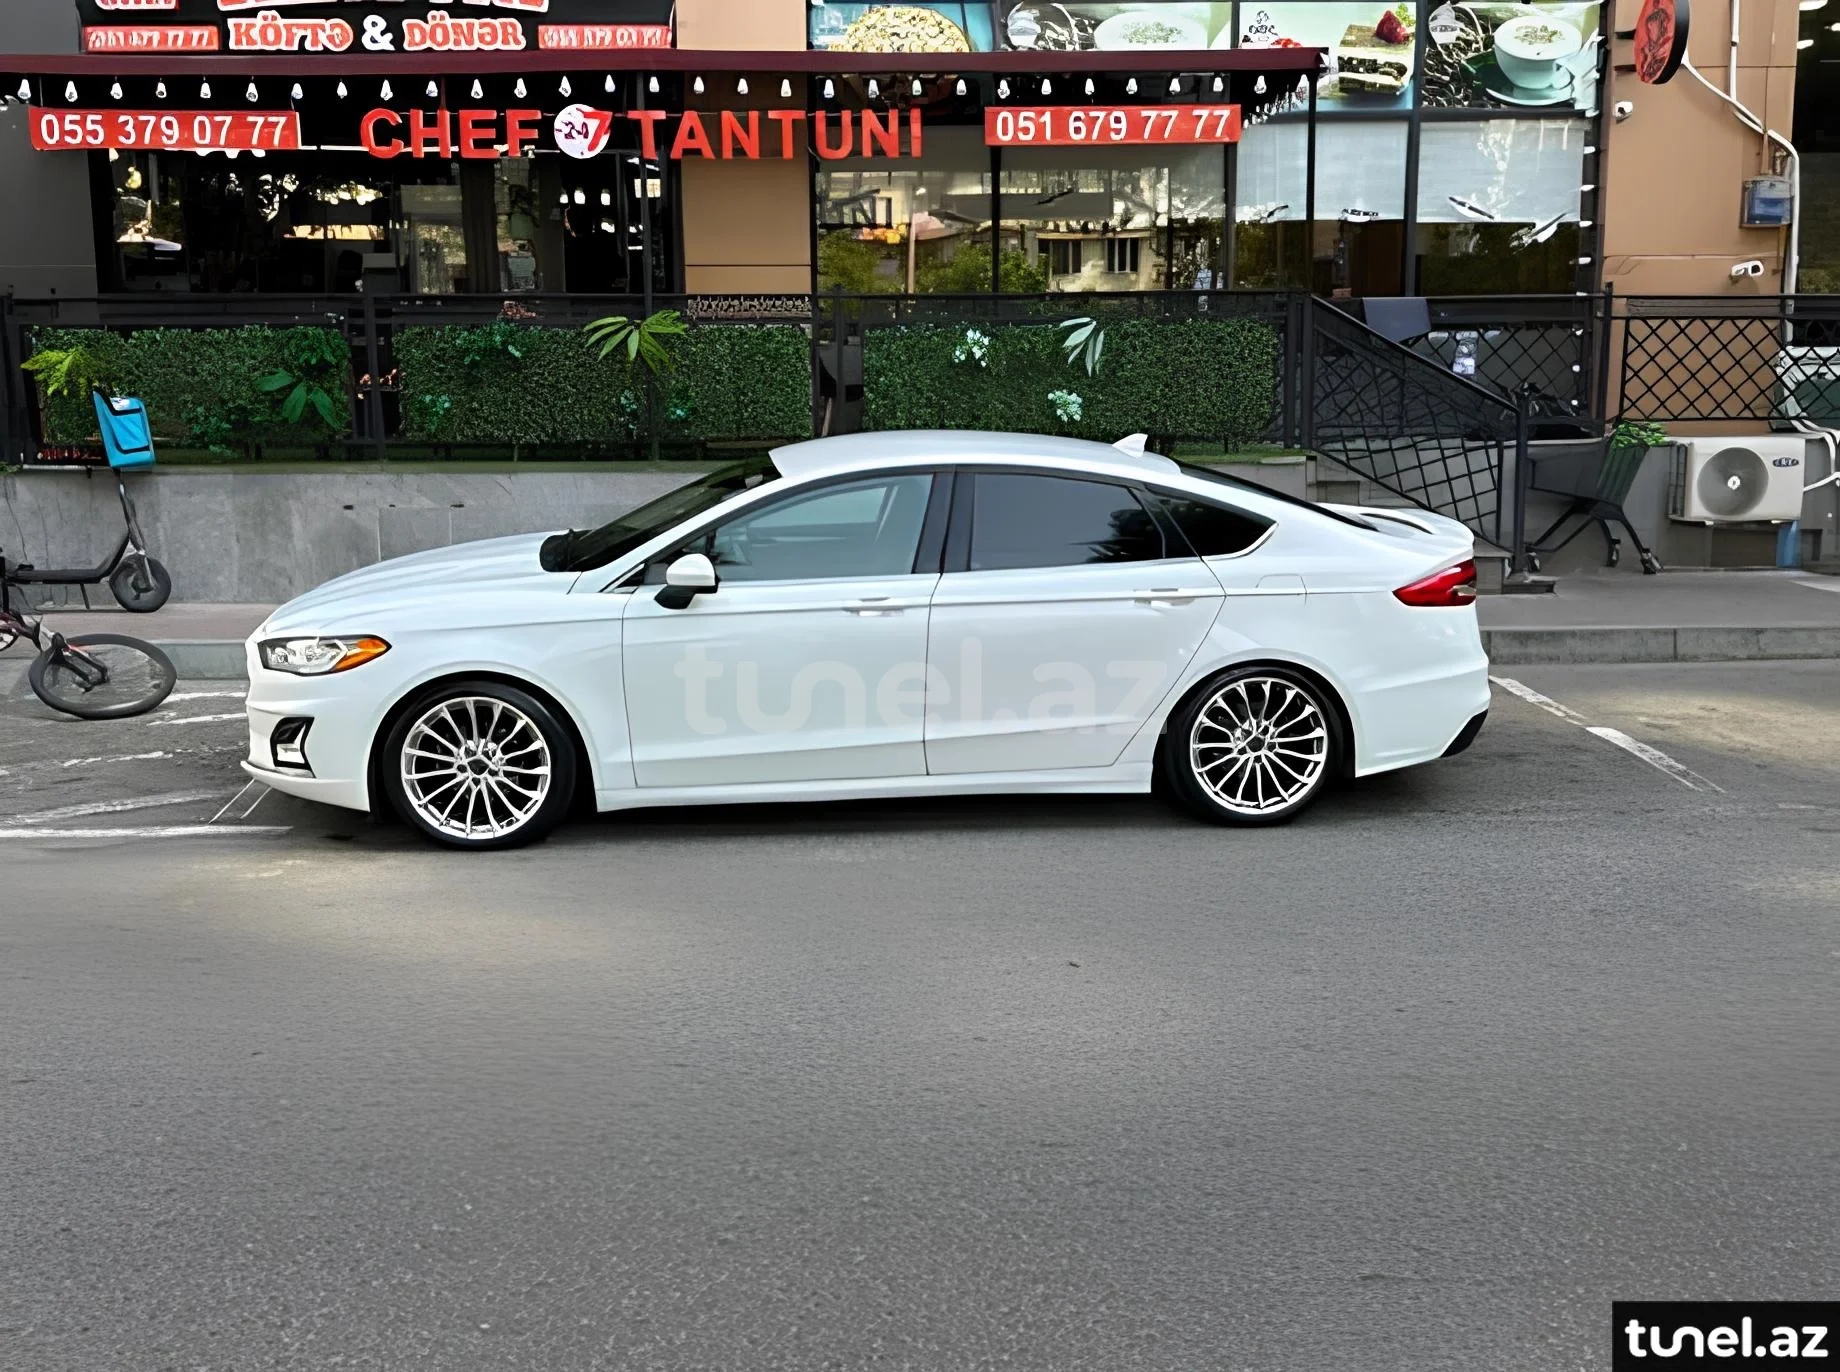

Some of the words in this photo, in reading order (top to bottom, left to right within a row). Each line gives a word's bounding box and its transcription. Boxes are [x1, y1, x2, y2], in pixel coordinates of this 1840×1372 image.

[361, 14, 395, 50] &
[40, 113, 105, 145] 055
[117, 114, 180, 145] 379
[193, 114, 233, 146] 07
[246, 115, 287, 147] 77
[360, 107, 542, 159] CHEF
[627, 108, 922, 160] TANTUNI
[996, 111, 1051, 141] 051
[1068, 110, 1127, 141] 679
[1140, 109, 1179, 140] 77
[1192, 108, 1231, 138] 77
